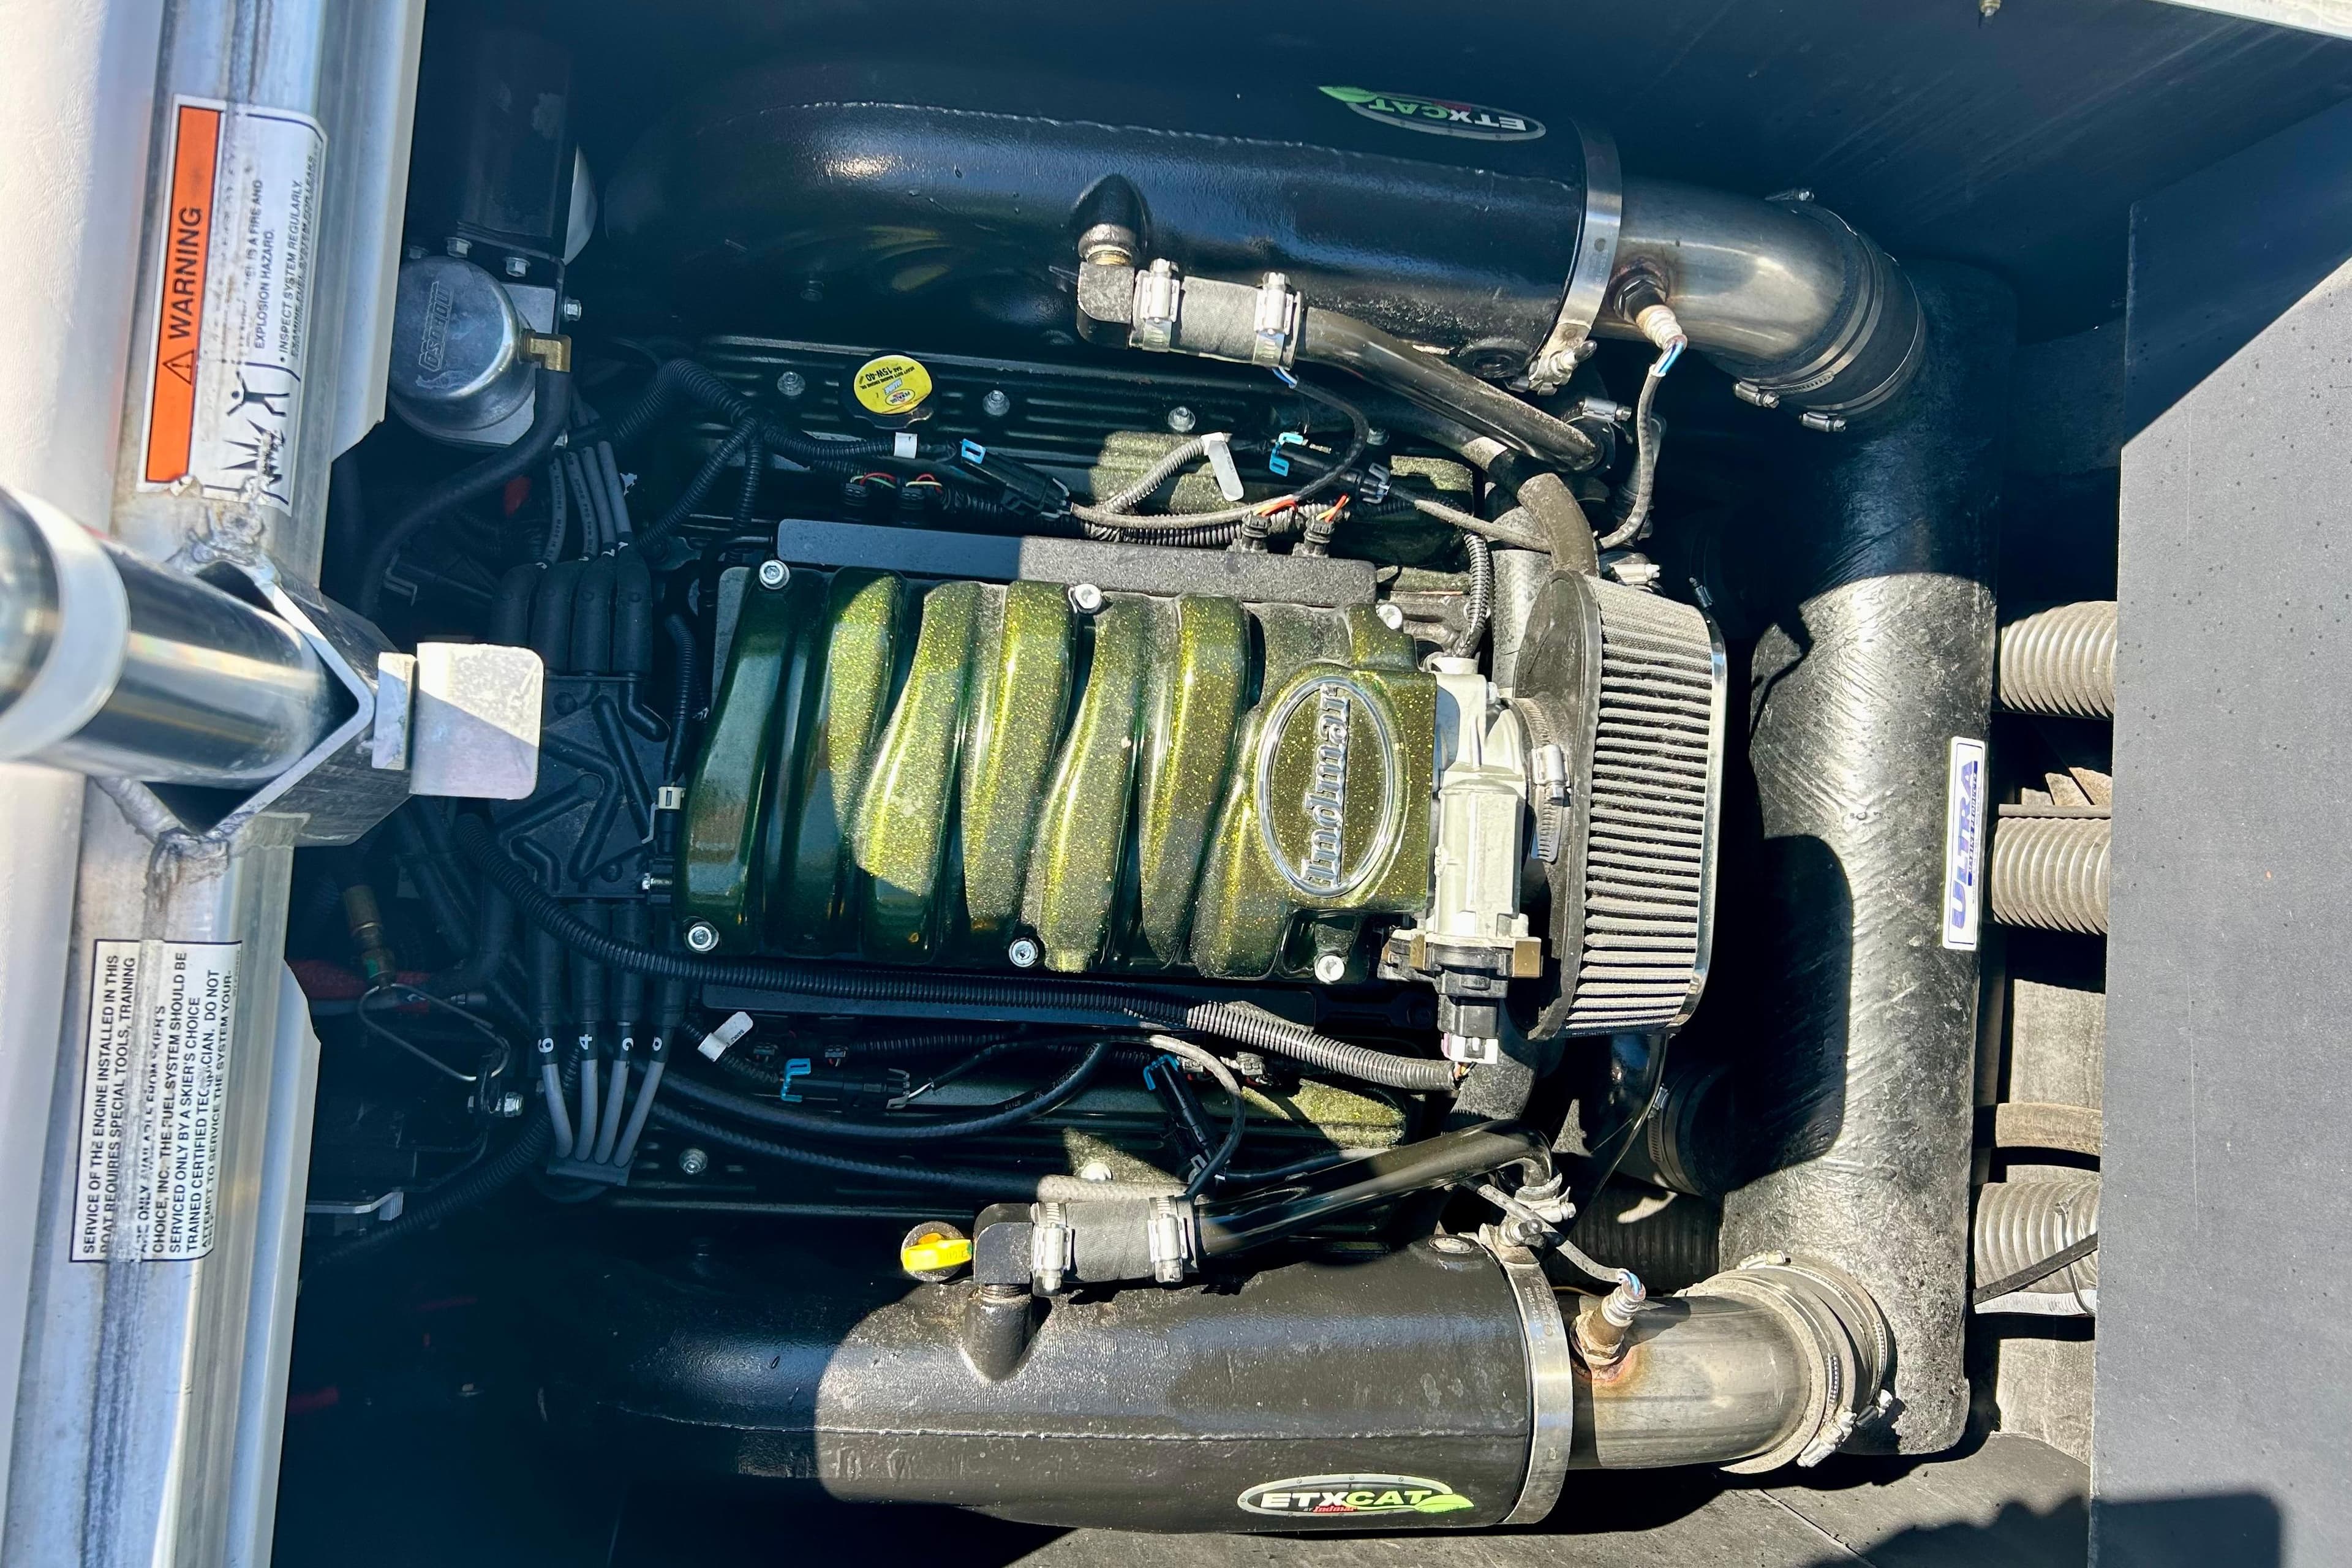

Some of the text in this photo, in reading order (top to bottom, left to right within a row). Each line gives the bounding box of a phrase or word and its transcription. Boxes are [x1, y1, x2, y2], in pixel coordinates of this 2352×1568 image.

[1368, 99, 1526, 130] ETXCAT
[250, 179, 263, 205] AND
[246, 237, 258, 246] A
[247, 207, 261, 235] FIRE
[167, 206, 201, 340] WARNING
[282, 252, 296, 300] SYSTEM
[254, 282, 270, 349] EXPLOSION
[277, 301, 292, 353] INSPECT
[866, 367, 892, 382] 15W-40
[1300, 684, 1349, 888] Indmar
[1951, 761, 1972, 929] ULTRA
[118, 957, 135, 1022] TRAINING
[206, 969, 220, 998] NOT
[221, 970, 233, 1012] YOUR-
[204, 1001, 217, 1021] DO
[114, 1024, 131, 1076] TOOLS,
[216, 1016, 228, 1070] SYSTEM
[538, 1038, 554, 1053] 6
[579, 1033, 592, 1050] 4
[83, 954, 118, 1254] SERVICE OF THE ENGINE INSTALLED IN THIS
[108, 1079, 126, 1137] SPECIAL
[151, 951, 187, 1253] CHOICE, INC. THE FUEL SYSTEM SHOULD BE
[213, 1072, 224, 1100] THE
[168, 996, 200, 1253] SERVICED ONLY BY A SKIER'S CHOICE
[208, 1102, 221, 1162] SERVICE
[102, 1140, 121, 1212] REQUIRES
[191, 1117, 208, 1188] CERTIFIED
[207, 1164, 215, 1182] TO
[137, 1185, 151, 1221] ONLY
[186, 1192, 202, 1253] TRAINED
[1261, 1490, 1432, 1507] ETXCAT
